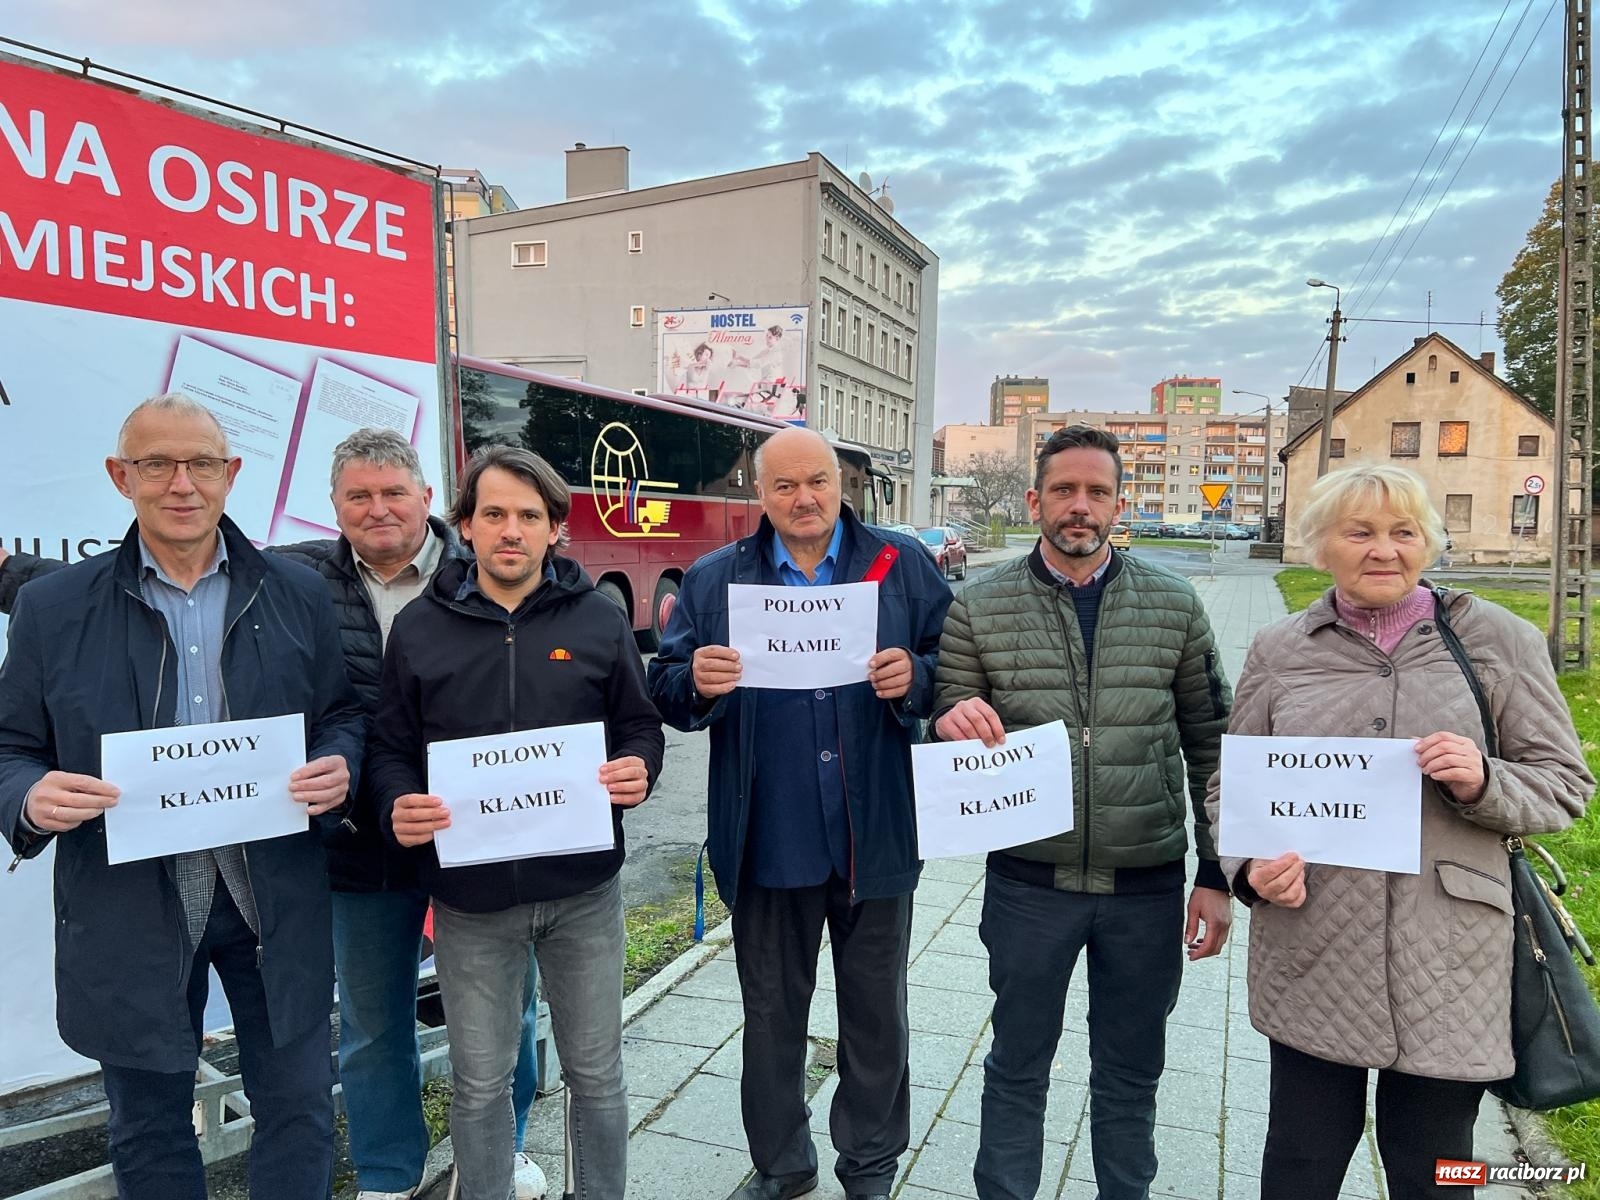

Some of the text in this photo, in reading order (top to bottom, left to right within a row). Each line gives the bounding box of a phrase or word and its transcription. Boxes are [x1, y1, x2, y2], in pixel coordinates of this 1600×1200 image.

[0, 102, 407, 262] NA OSIRZE
[0, 211, 357, 328] MIEJSKICH:
[710, 313, 756, 328] HOSTEL
[737, 469, 743, 487] 5
[763, 597, 845, 613] POLOWY
[767, 638, 841, 653] KŁAMIE
[152, 734, 261, 762] POLOWY
[472, 741, 566, 768] POLOWY
[953, 743, 1035, 772] POLOWY
[1266, 752, 1374, 770] POLOWY
[160, 782, 259, 809] KŁAMIE
[479, 789, 566, 814] KŁAMIE
[960, 788, 1037, 816] KŁAMIE
[1270, 800, 1367, 820] KŁAMIE
